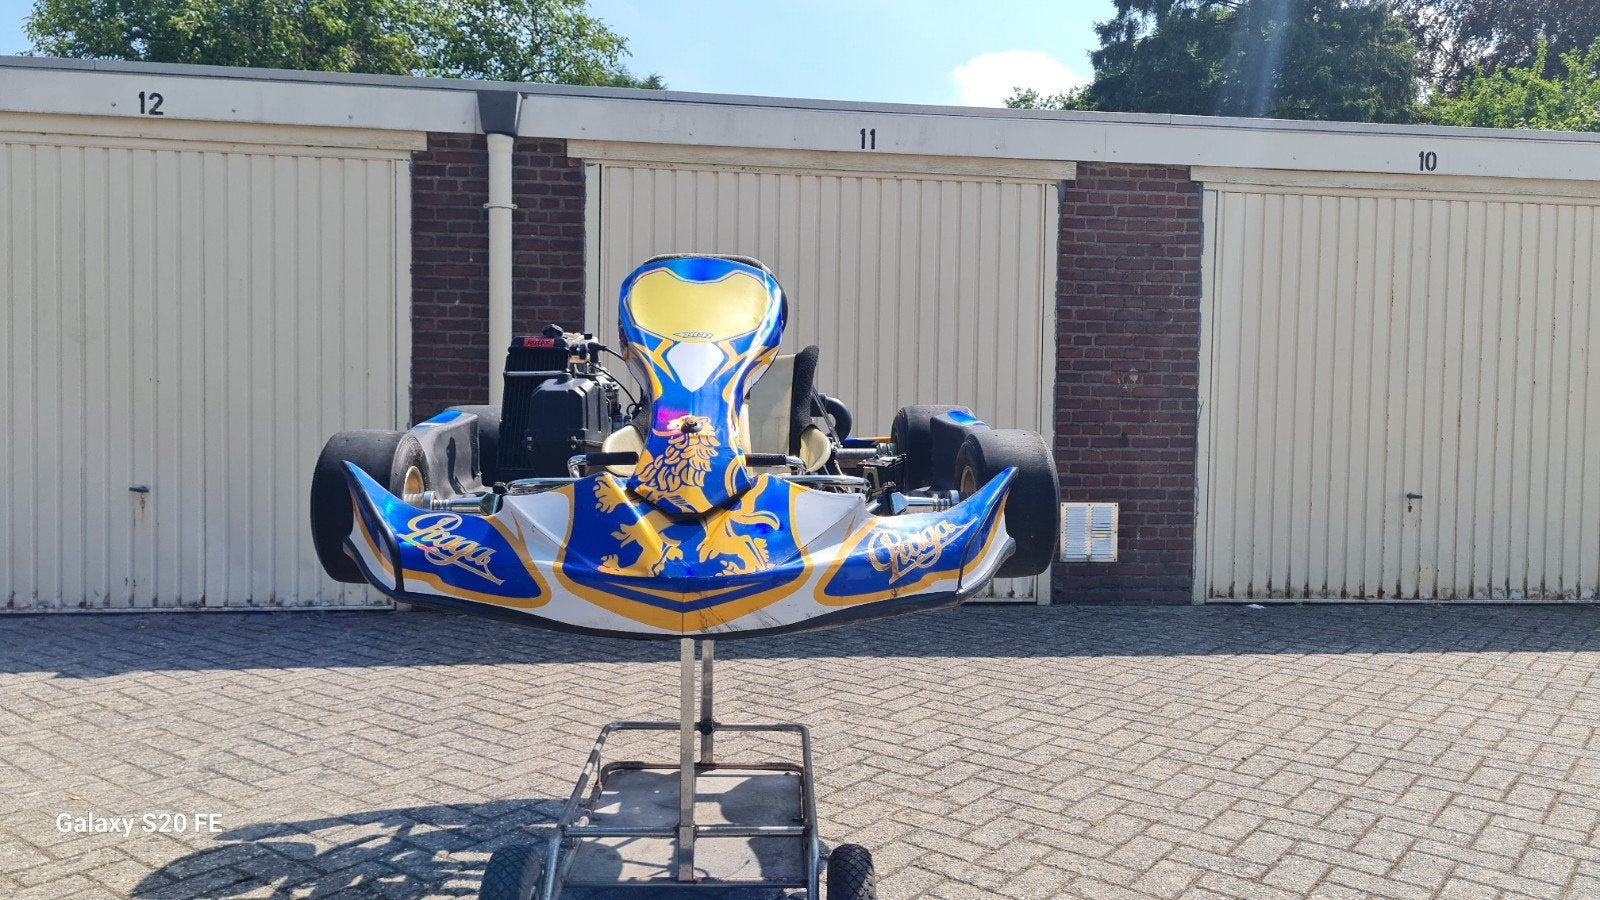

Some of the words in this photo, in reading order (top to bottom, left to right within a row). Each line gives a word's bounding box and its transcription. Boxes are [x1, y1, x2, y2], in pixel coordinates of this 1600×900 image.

[139, 91, 164, 115] 12
[860, 128, 876, 150] 11
[1419, 151, 1437, 171] 10
[397, 512, 506, 585] Praga
[867, 516, 979, 585] Praga
